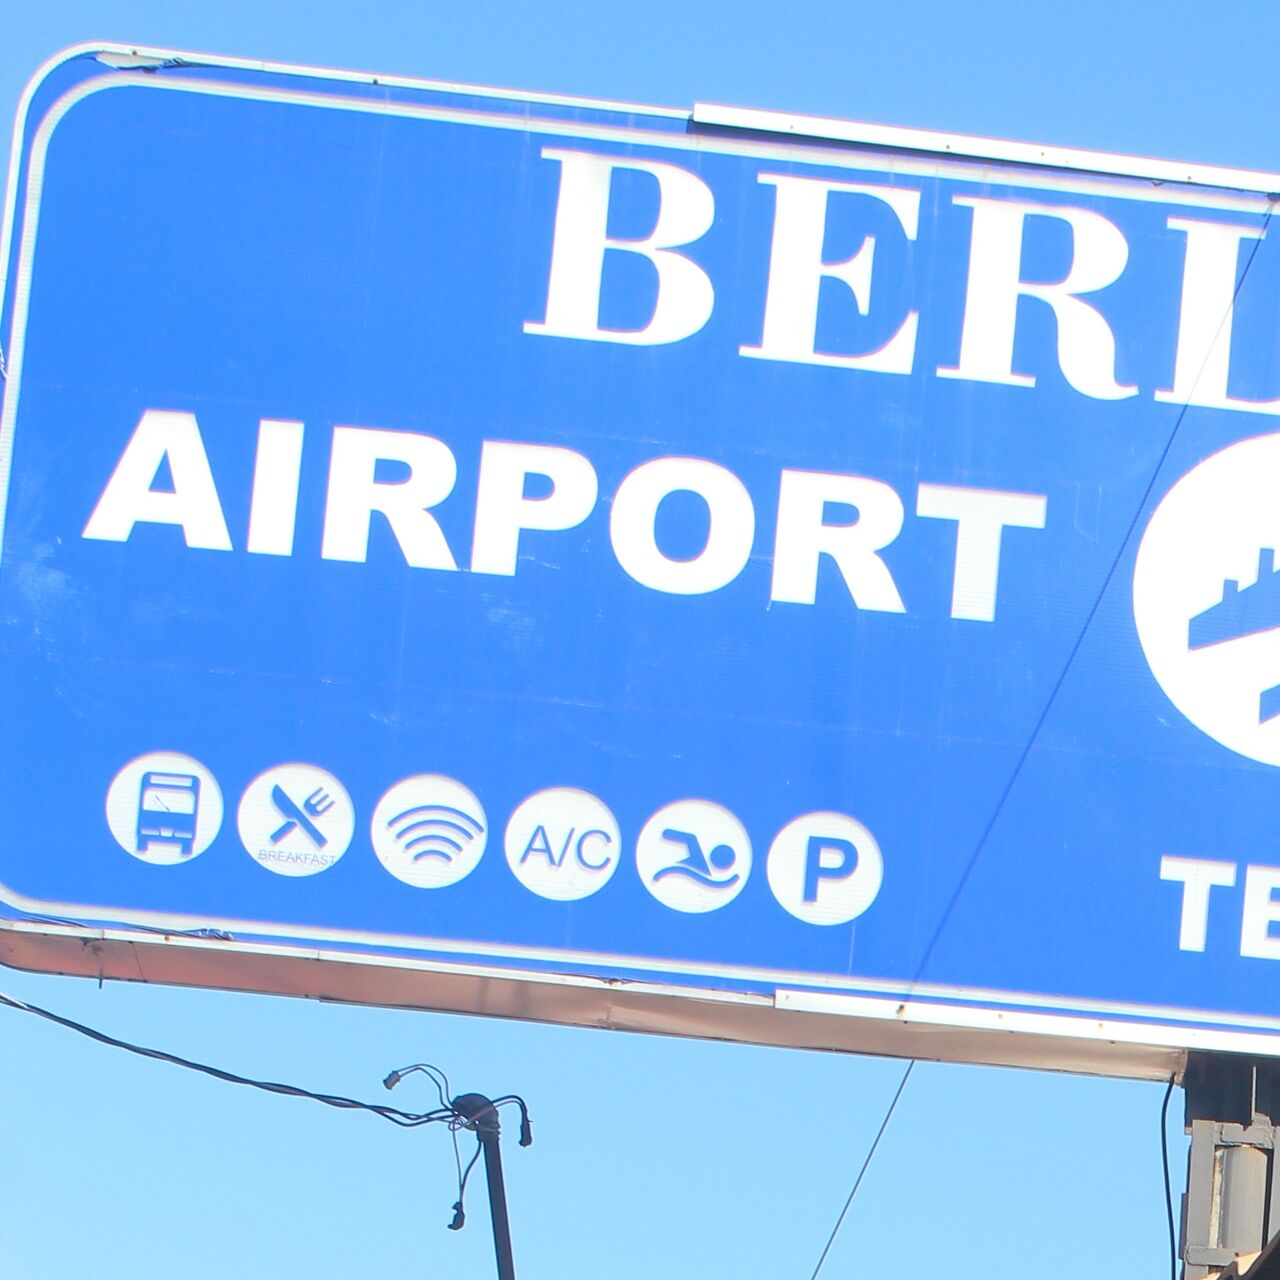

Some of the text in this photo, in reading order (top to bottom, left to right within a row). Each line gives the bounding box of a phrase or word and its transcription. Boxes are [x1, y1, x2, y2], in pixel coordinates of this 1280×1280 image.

[82, 409, 1048, 622] AIRPORT
[259, 849, 336, 867] BREAKFAST
[520, 823, 612, 872] A/C
[803, 836, 859, 903] P
